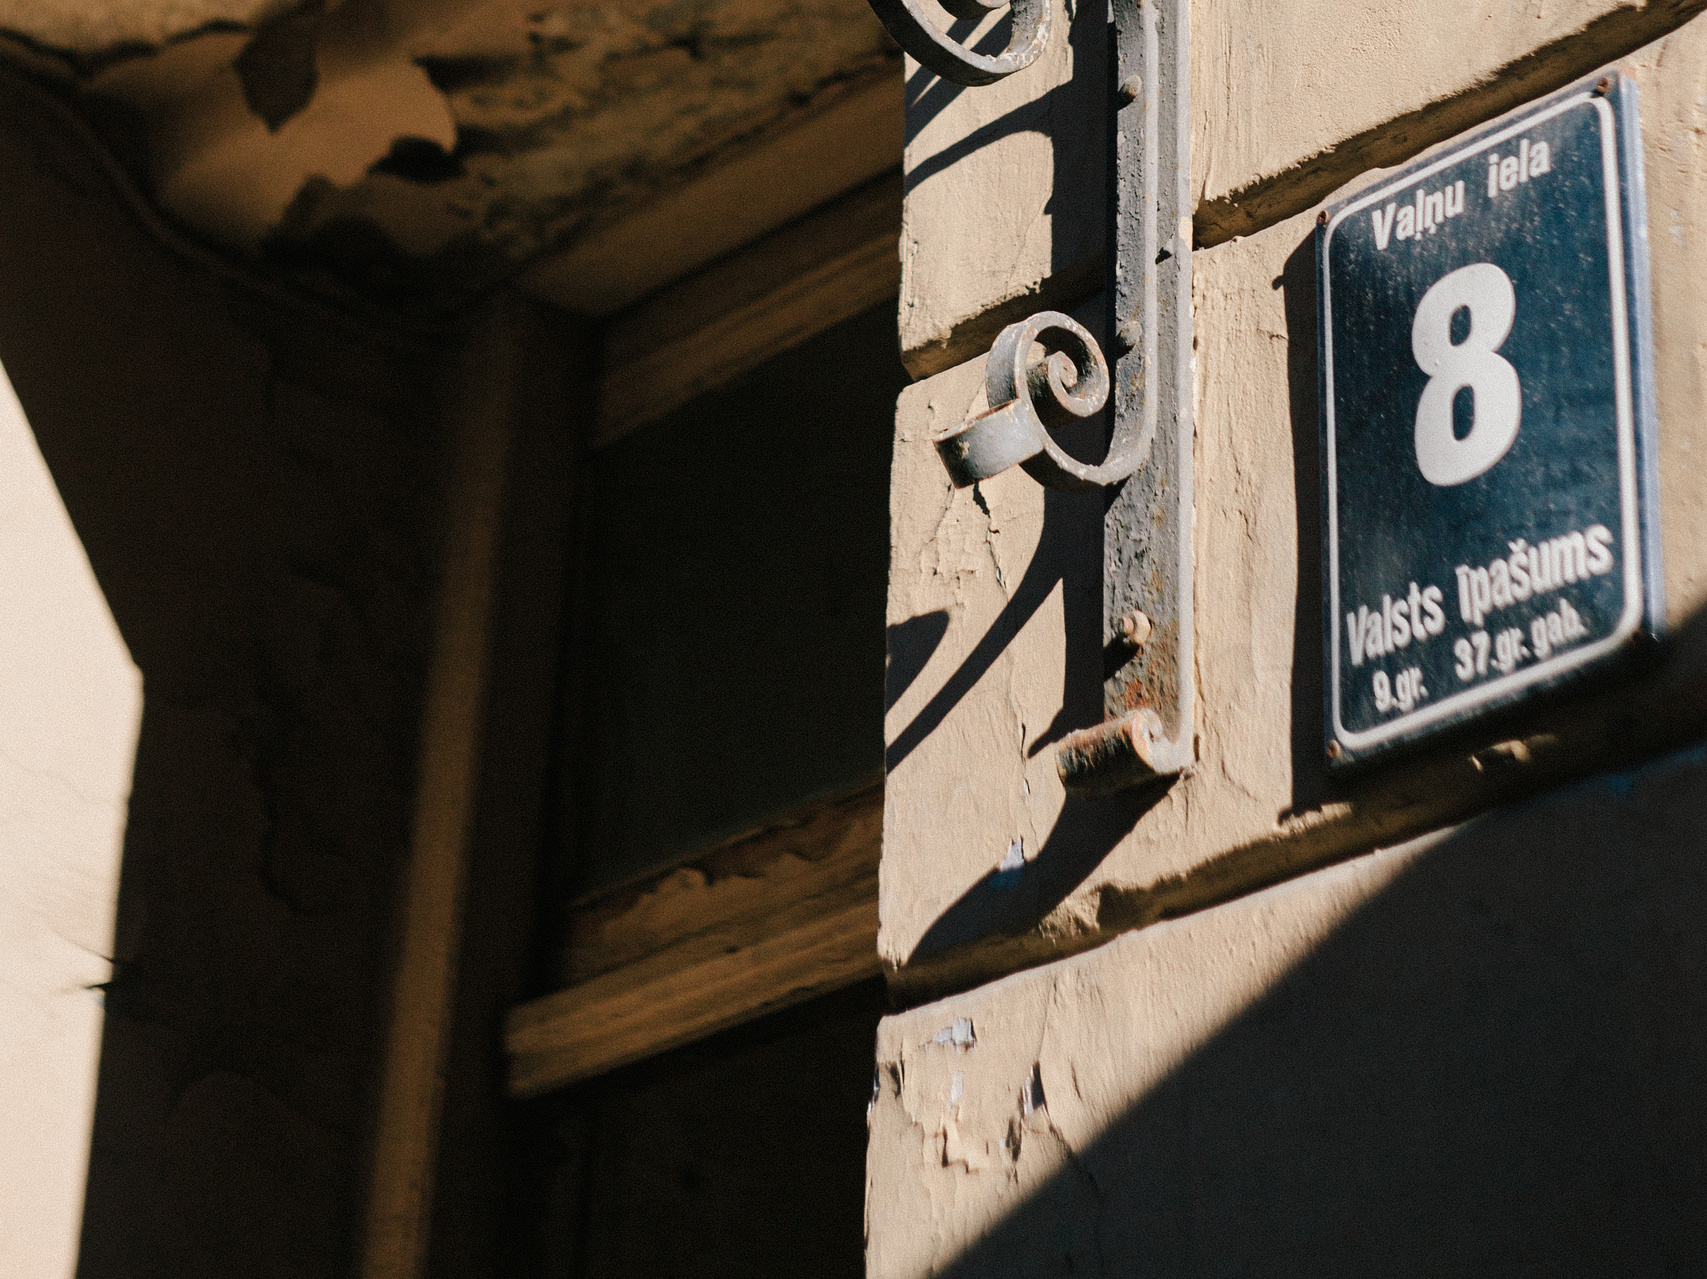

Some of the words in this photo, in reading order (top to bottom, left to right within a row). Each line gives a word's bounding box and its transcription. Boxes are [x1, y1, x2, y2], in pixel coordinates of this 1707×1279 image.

[1372, 180, 1465, 250] Vaļņu
[1488, 139, 1551, 198] iela
[1411, 262, 1522, 487] 8
[1347, 582, 1447, 667] Valsts
